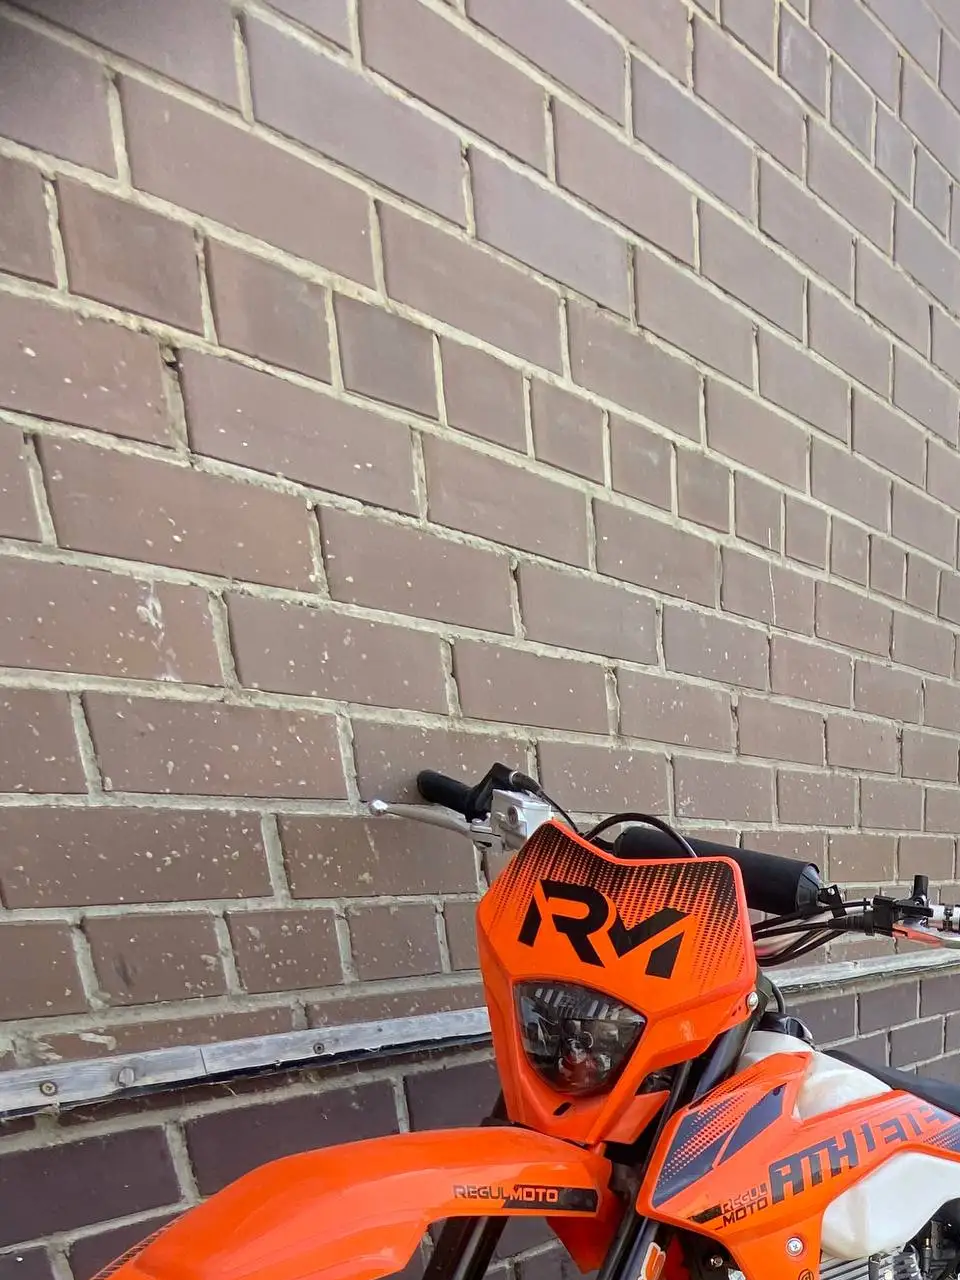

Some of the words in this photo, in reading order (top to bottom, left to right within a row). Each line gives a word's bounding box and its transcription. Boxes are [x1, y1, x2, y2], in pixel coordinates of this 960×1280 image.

[453, 1185, 559, 1203] REGULMOTO
[720, 1183, 769, 1214] REGUL
[722, 1196, 769, 1227] MOTO
